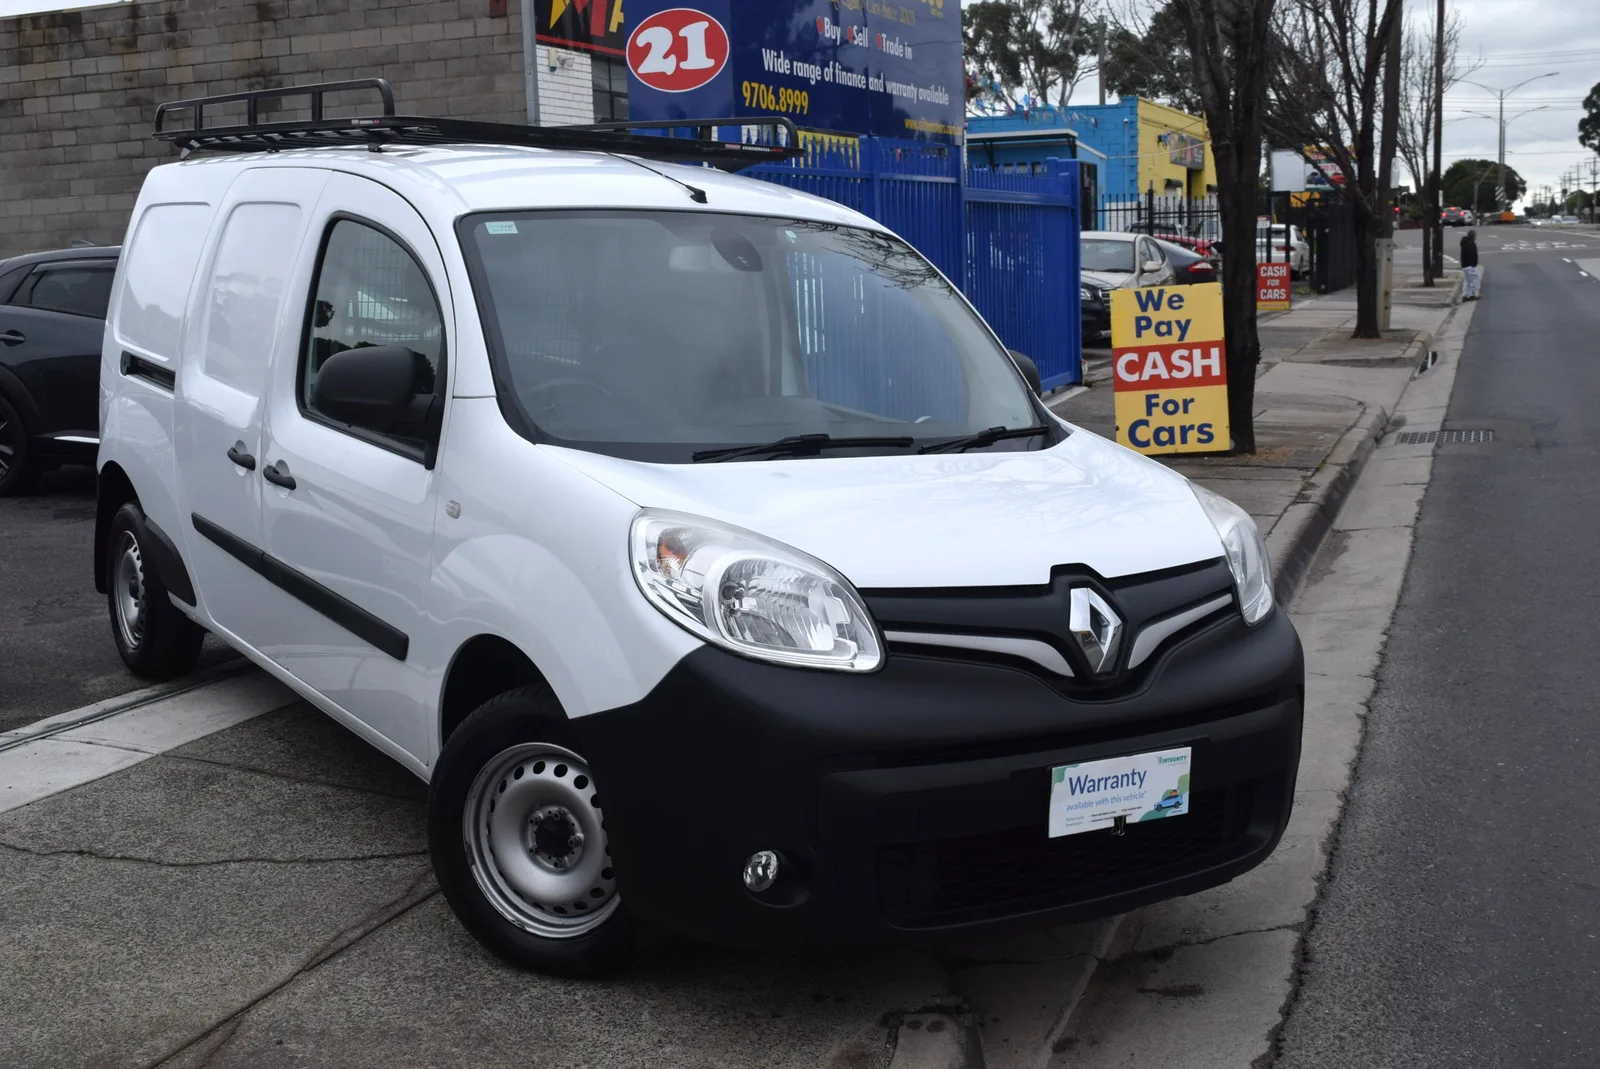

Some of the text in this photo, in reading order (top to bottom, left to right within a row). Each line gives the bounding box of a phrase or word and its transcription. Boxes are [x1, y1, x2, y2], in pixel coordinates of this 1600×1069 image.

[635, 20, 716, 76] 21
[823, 17, 913, 60] Buy Sell Trade in
[762, 48, 949, 106] Wide range of finance and warranty available
[742, 80, 809, 115] 9706.8999
[1260, 266, 1287, 277] CASH
[1267, 279, 1280, 287] FOR
[1134, 288, 1185, 313] We
[1260, 288, 1287, 300] CARS
[1135, 315, 1192, 342] Pay
[1116, 347, 1221, 383] CASH
[1145, 393, 1195, 417] For
[1128, 419, 1215, 448] Cars
[1068, 768, 1147, 796] Warranty
[1066, 797, 1094, 812] available
[1095, 795, 1109, 806] with
[1110, 794, 1122, 804] this
